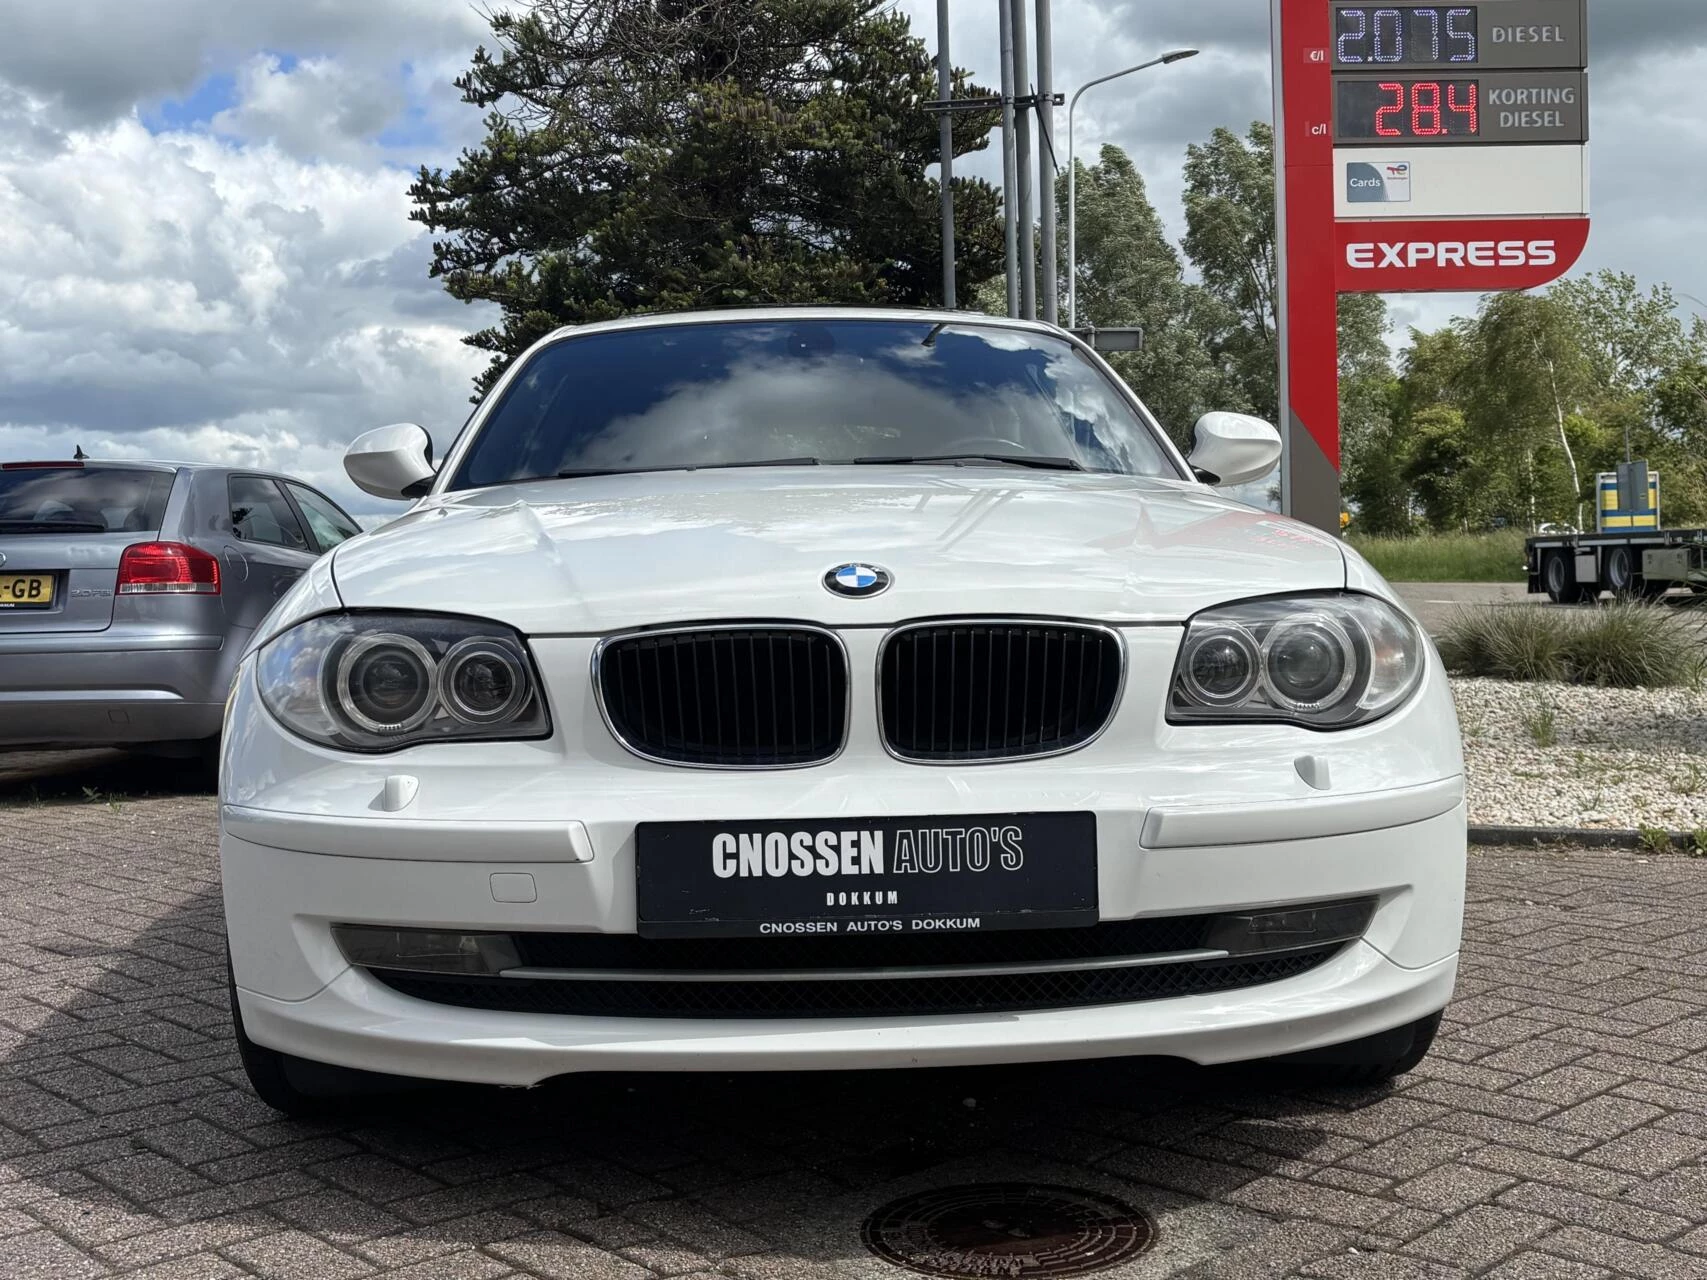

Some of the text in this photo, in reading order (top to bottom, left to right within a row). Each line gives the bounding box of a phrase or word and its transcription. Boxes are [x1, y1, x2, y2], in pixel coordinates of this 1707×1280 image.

[1338, 9, 1475, 62] 2.075
[1492, 26, 1565, 43] DIESEL
[1488, 88, 1575, 105] KORTING
[1375, 83, 1477, 136] 28.4
[1499, 111, 1564, 128] DIESEL
[1350, 177, 1381, 187] Cards
[1346, 240, 1556, 268] EXPRESS
[0, 579, 42, 599] -GB
[712, 826, 1024, 878] CNOSSEN AUTO'S
[826, 891, 898, 906] DOKKUM
[759, 918, 981, 934] CNOSSEN AUTO'S DOKKUM
